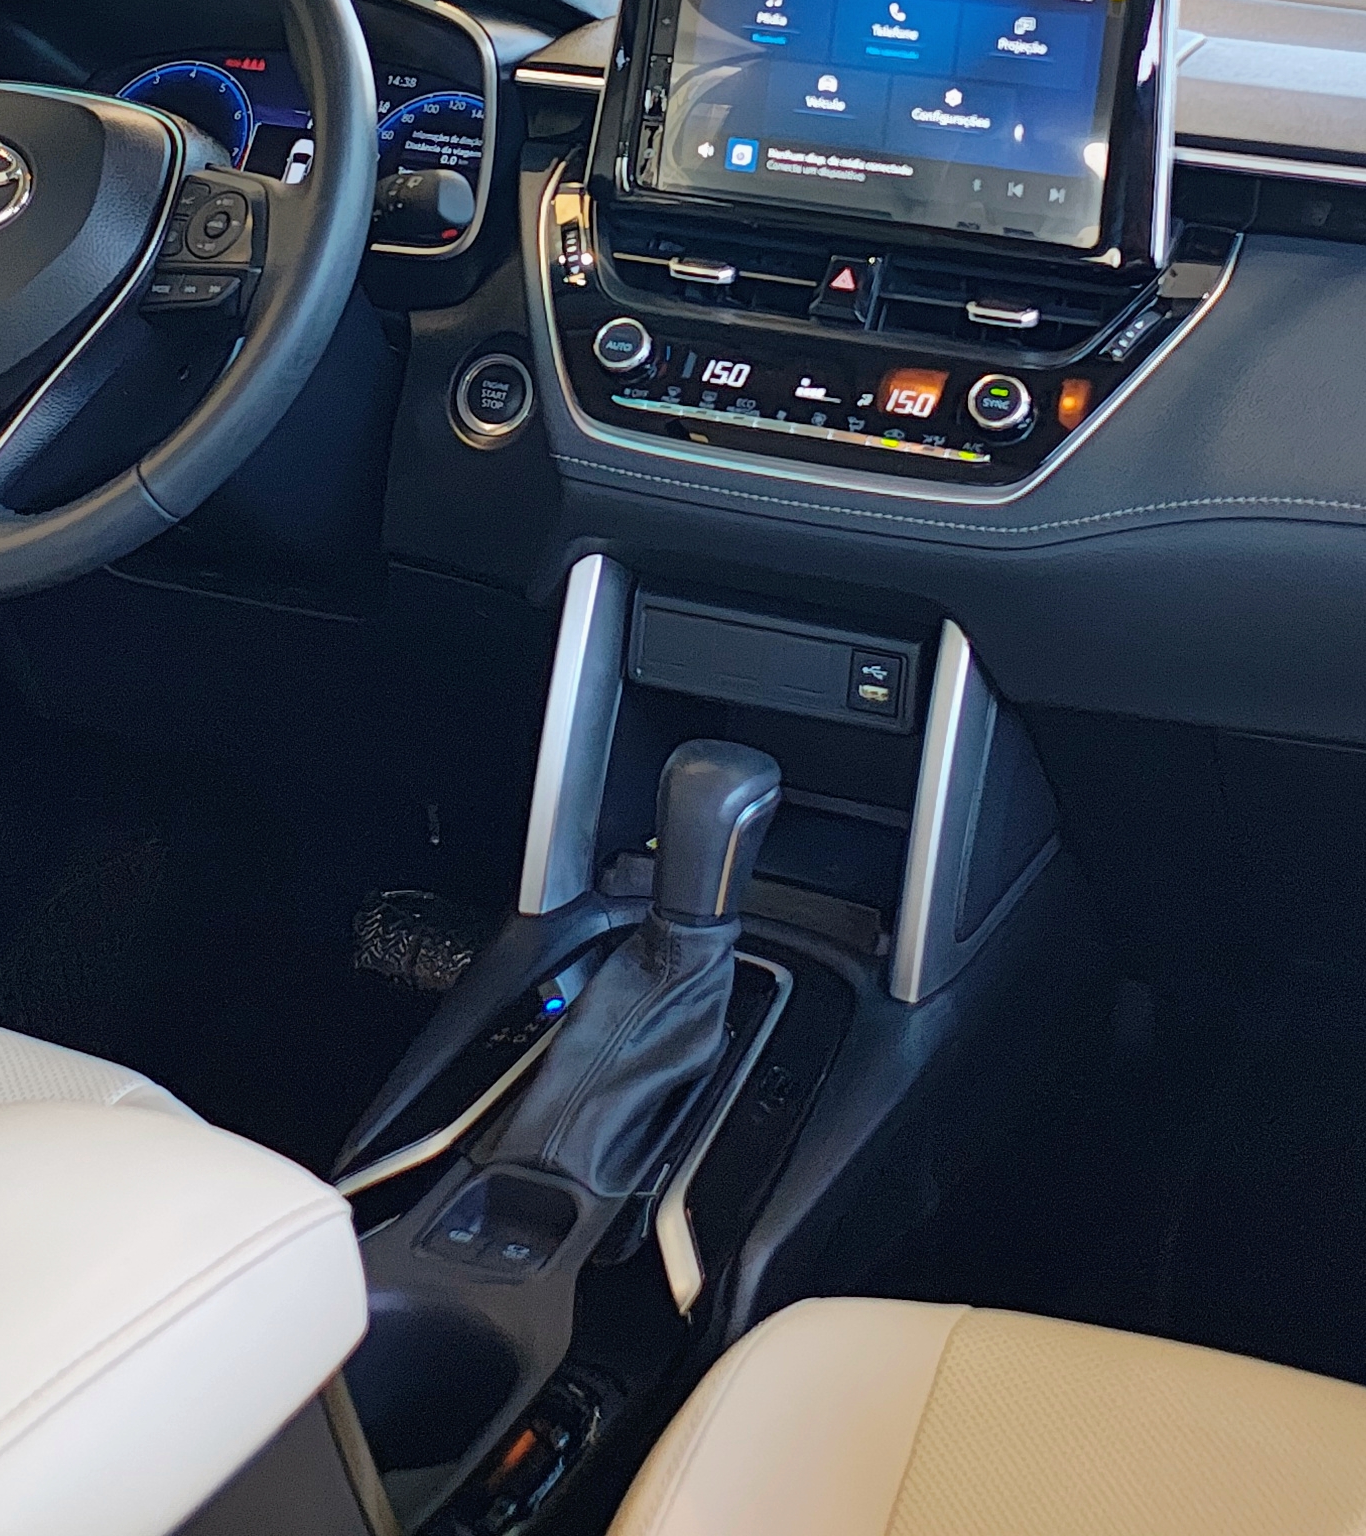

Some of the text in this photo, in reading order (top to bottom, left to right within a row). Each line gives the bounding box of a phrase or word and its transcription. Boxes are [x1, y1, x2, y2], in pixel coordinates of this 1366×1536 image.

[152, 75, 161, 85] 3
[387, 75, 418, 88] 14:38
[218, 83, 227, 93] 5
[422, 103, 440, 114] 100
[448, 100, 467, 111] 120
[234, 110, 243, 121] 6
[400, 112, 415, 124] 80
[911, 107, 991, 129] Configurações
[381, 130, 395, 141] 60
[440, 155, 458, 166] 0.0
[605, 340, 634, 353] AUTO
[481, 389, 507, 400] START
[481, 398, 504, 410] STOP
[982, 397, 1010, 411] SYNC
